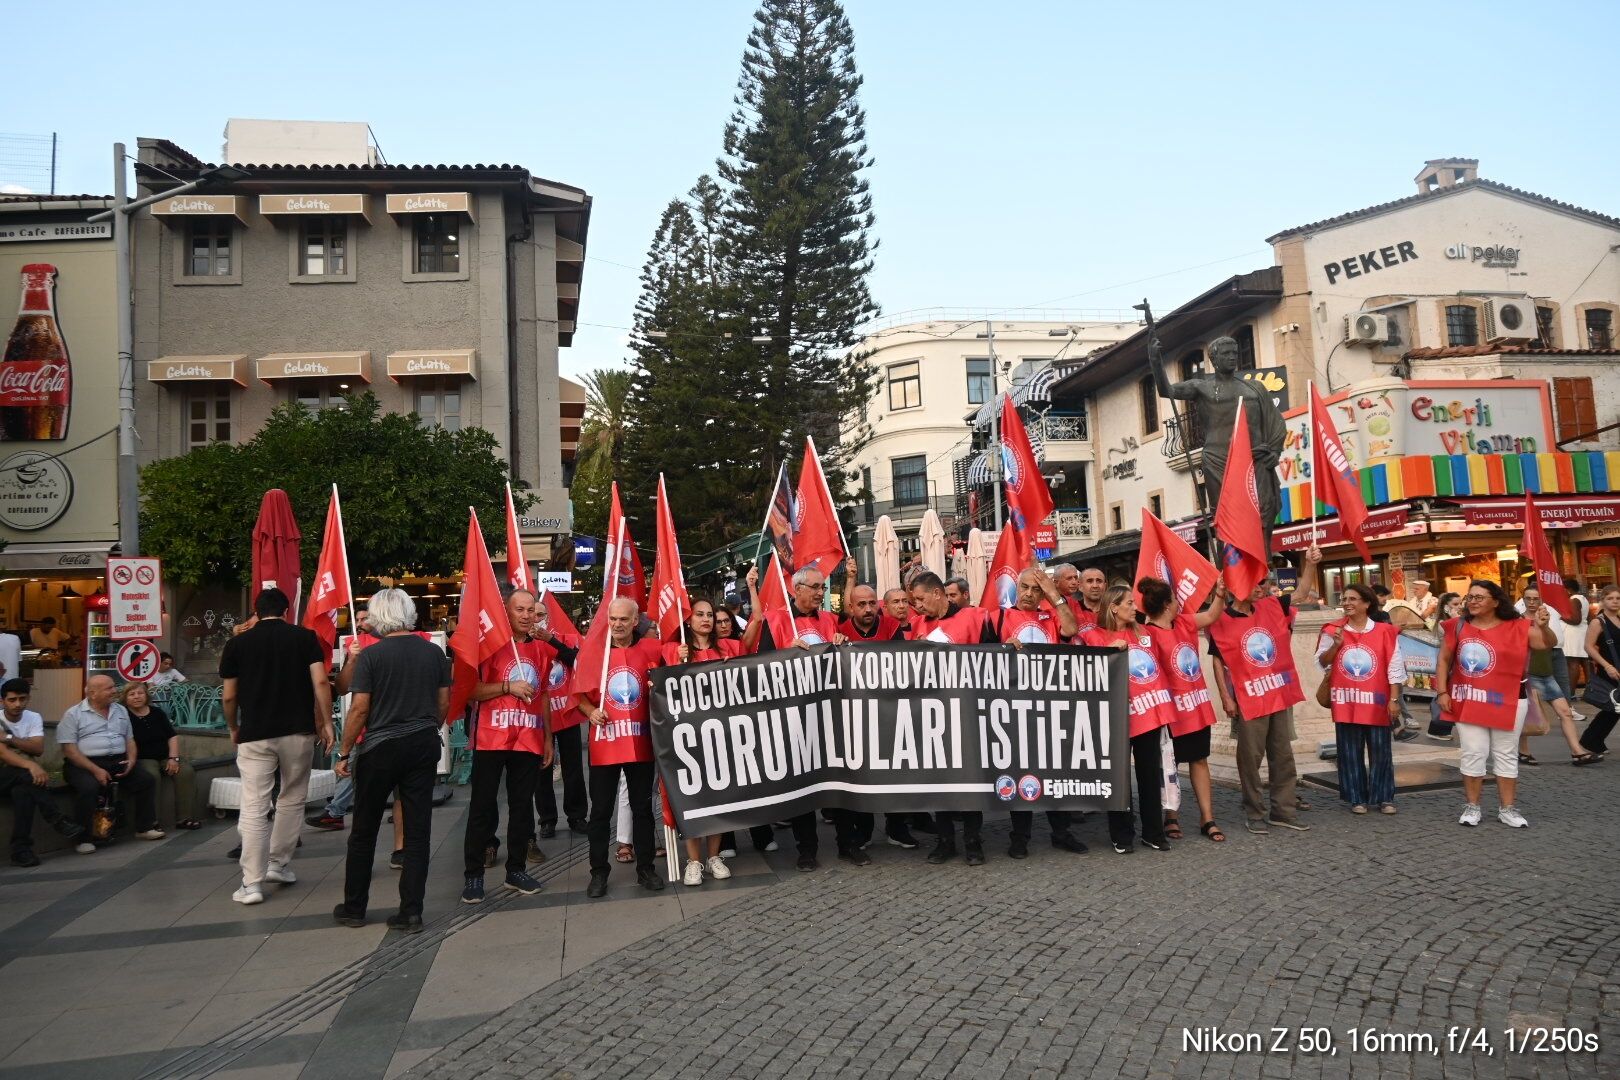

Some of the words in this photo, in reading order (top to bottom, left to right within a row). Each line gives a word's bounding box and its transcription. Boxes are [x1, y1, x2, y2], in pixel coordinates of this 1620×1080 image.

[19, 228, 47, 237] Cafe
[1323, 240, 1419, 285] PEKER
[1471, 244, 1520, 263] peker
[0, 364, 67, 394] Coca-Cola
[520, 517, 562, 529] Bakery
[1540, 507, 1572, 519] ENERJİ
[1574, 507, 1615, 518] VİTAMİN
[58, 554, 91, 565] Coca-Cola
[665, 651, 843, 721] ÇOCUKLARIMIZI
[850, 651, 1010, 690] KORUYAMAYAN
[672, 697, 963, 796] SORUMLULARI
[1043, 778, 1113, 799] Eğitimiş
